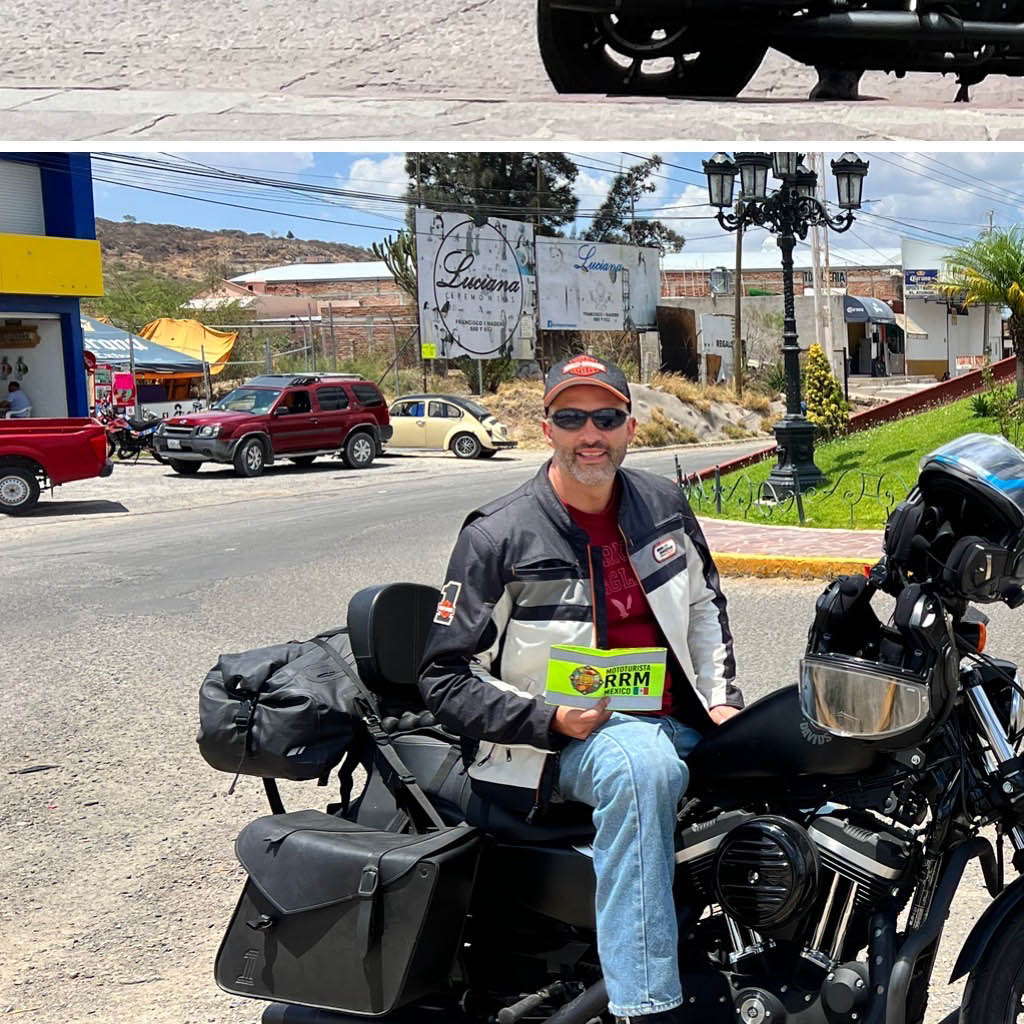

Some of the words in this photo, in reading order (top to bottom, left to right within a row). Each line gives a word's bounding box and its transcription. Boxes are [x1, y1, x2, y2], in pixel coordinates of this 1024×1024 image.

[574, 244, 623, 272] Luciana
[437, 249, 520, 292] Luciana
[604, 672, 651, 688] RRM
[606, 664, 651, 674] MOTOTURISTA
